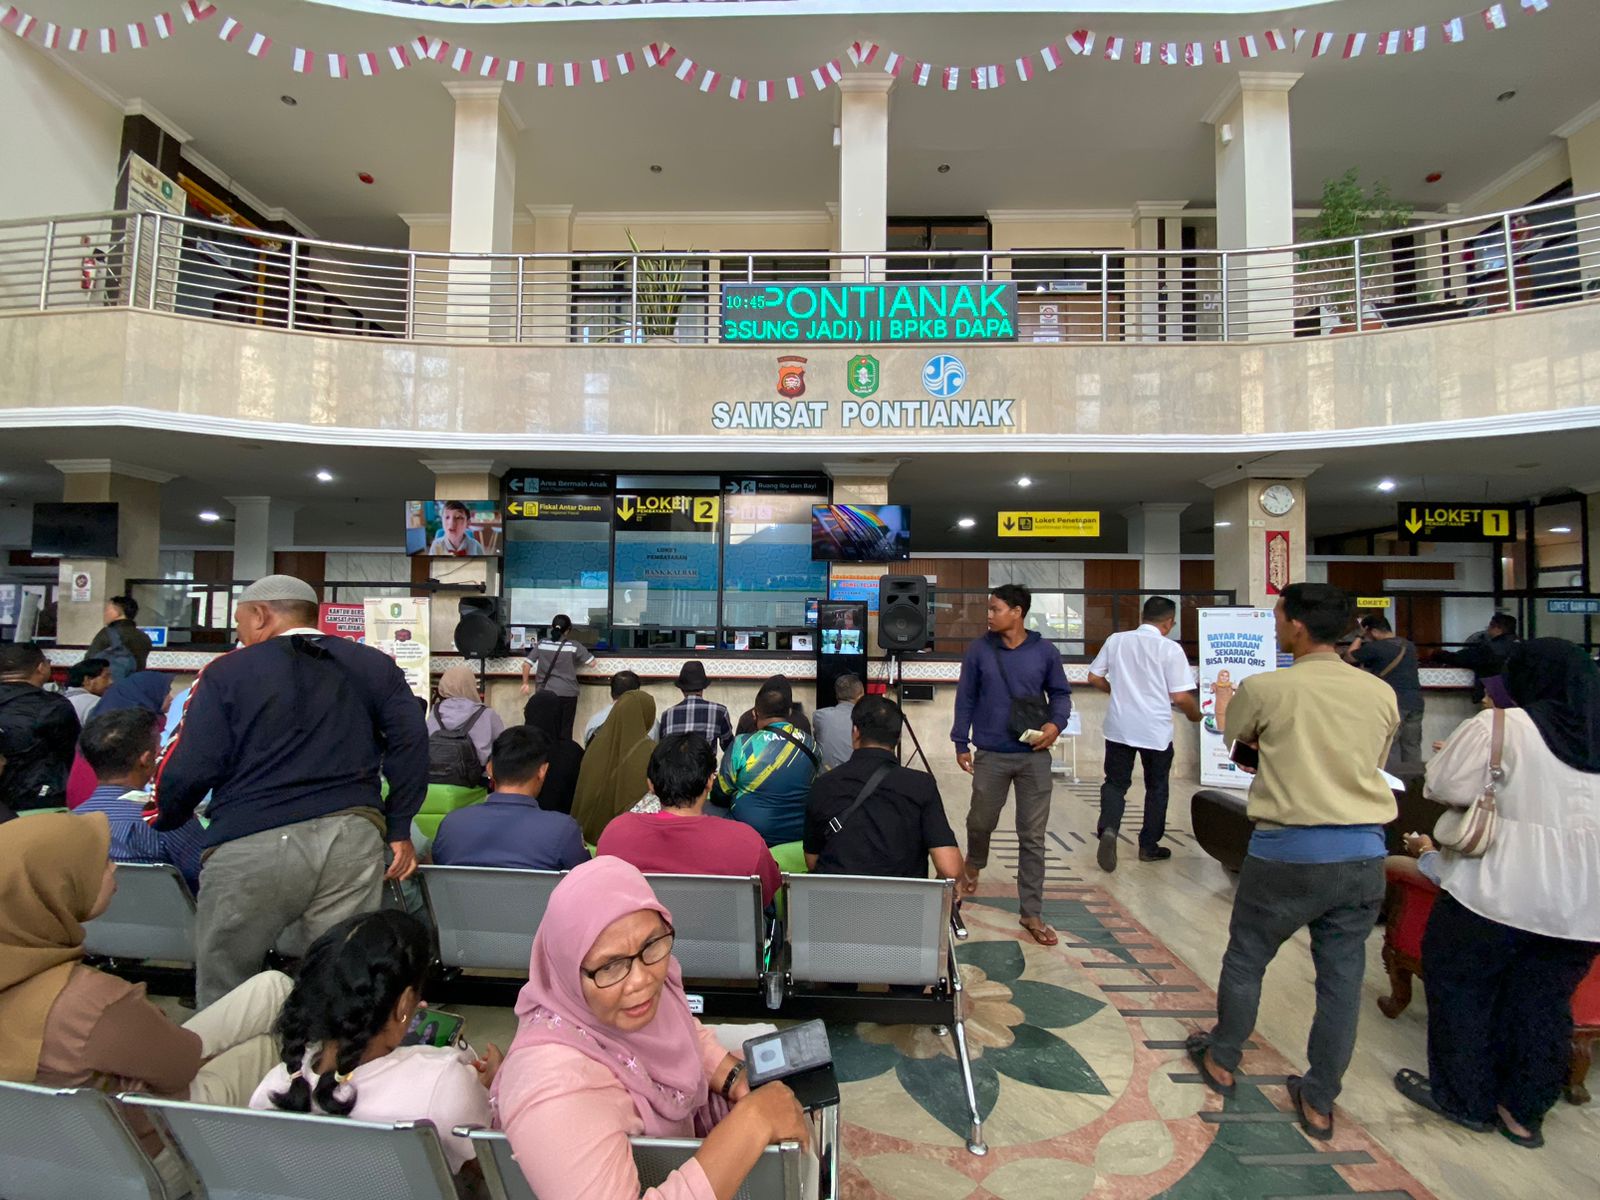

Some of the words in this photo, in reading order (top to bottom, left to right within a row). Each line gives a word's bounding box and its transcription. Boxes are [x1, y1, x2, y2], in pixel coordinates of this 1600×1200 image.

[726, 295, 765, 309] 10:45
[765, 286, 1008, 319] PONTIANAK
[806, 320, 863, 341] JADI)
[889, 319, 948, 339] BPKB
[955, 318, 1014, 338] DAPA
[711, 401, 828, 429] SAMSAT
[840, 399, 1015, 428] PONTIANAK
[558, 480, 588, 488] Bermain
[539, 503, 558, 511] Fiskal
[558, 503, 577, 511] Antar
[577, 504, 602, 512] Daerah
[637, 496, 693, 510] LOKET
[699, 500, 713, 519] 2
[1057, 517, 1097, 525] Penetapan
[1424, 508, 1481, 522] LOKET
[1491, 513, 1500, 532] 1
[644, 568, 668, 577] BANK
[668, 569, 698, 577] KALBAR
[1207, 633, 1235, 641] BAYAR
[1237, 633, 1263, 642] PAJAK
[1210, 640, 1260, 650] KENDARAAN
[1214, 649, 1255, 657] SEKARANG
[1205, 657, 1223, 666] BISA
[1223, 656, 1246, 664] PAKAI
[1248, 658, 1266, 667] QRIS
